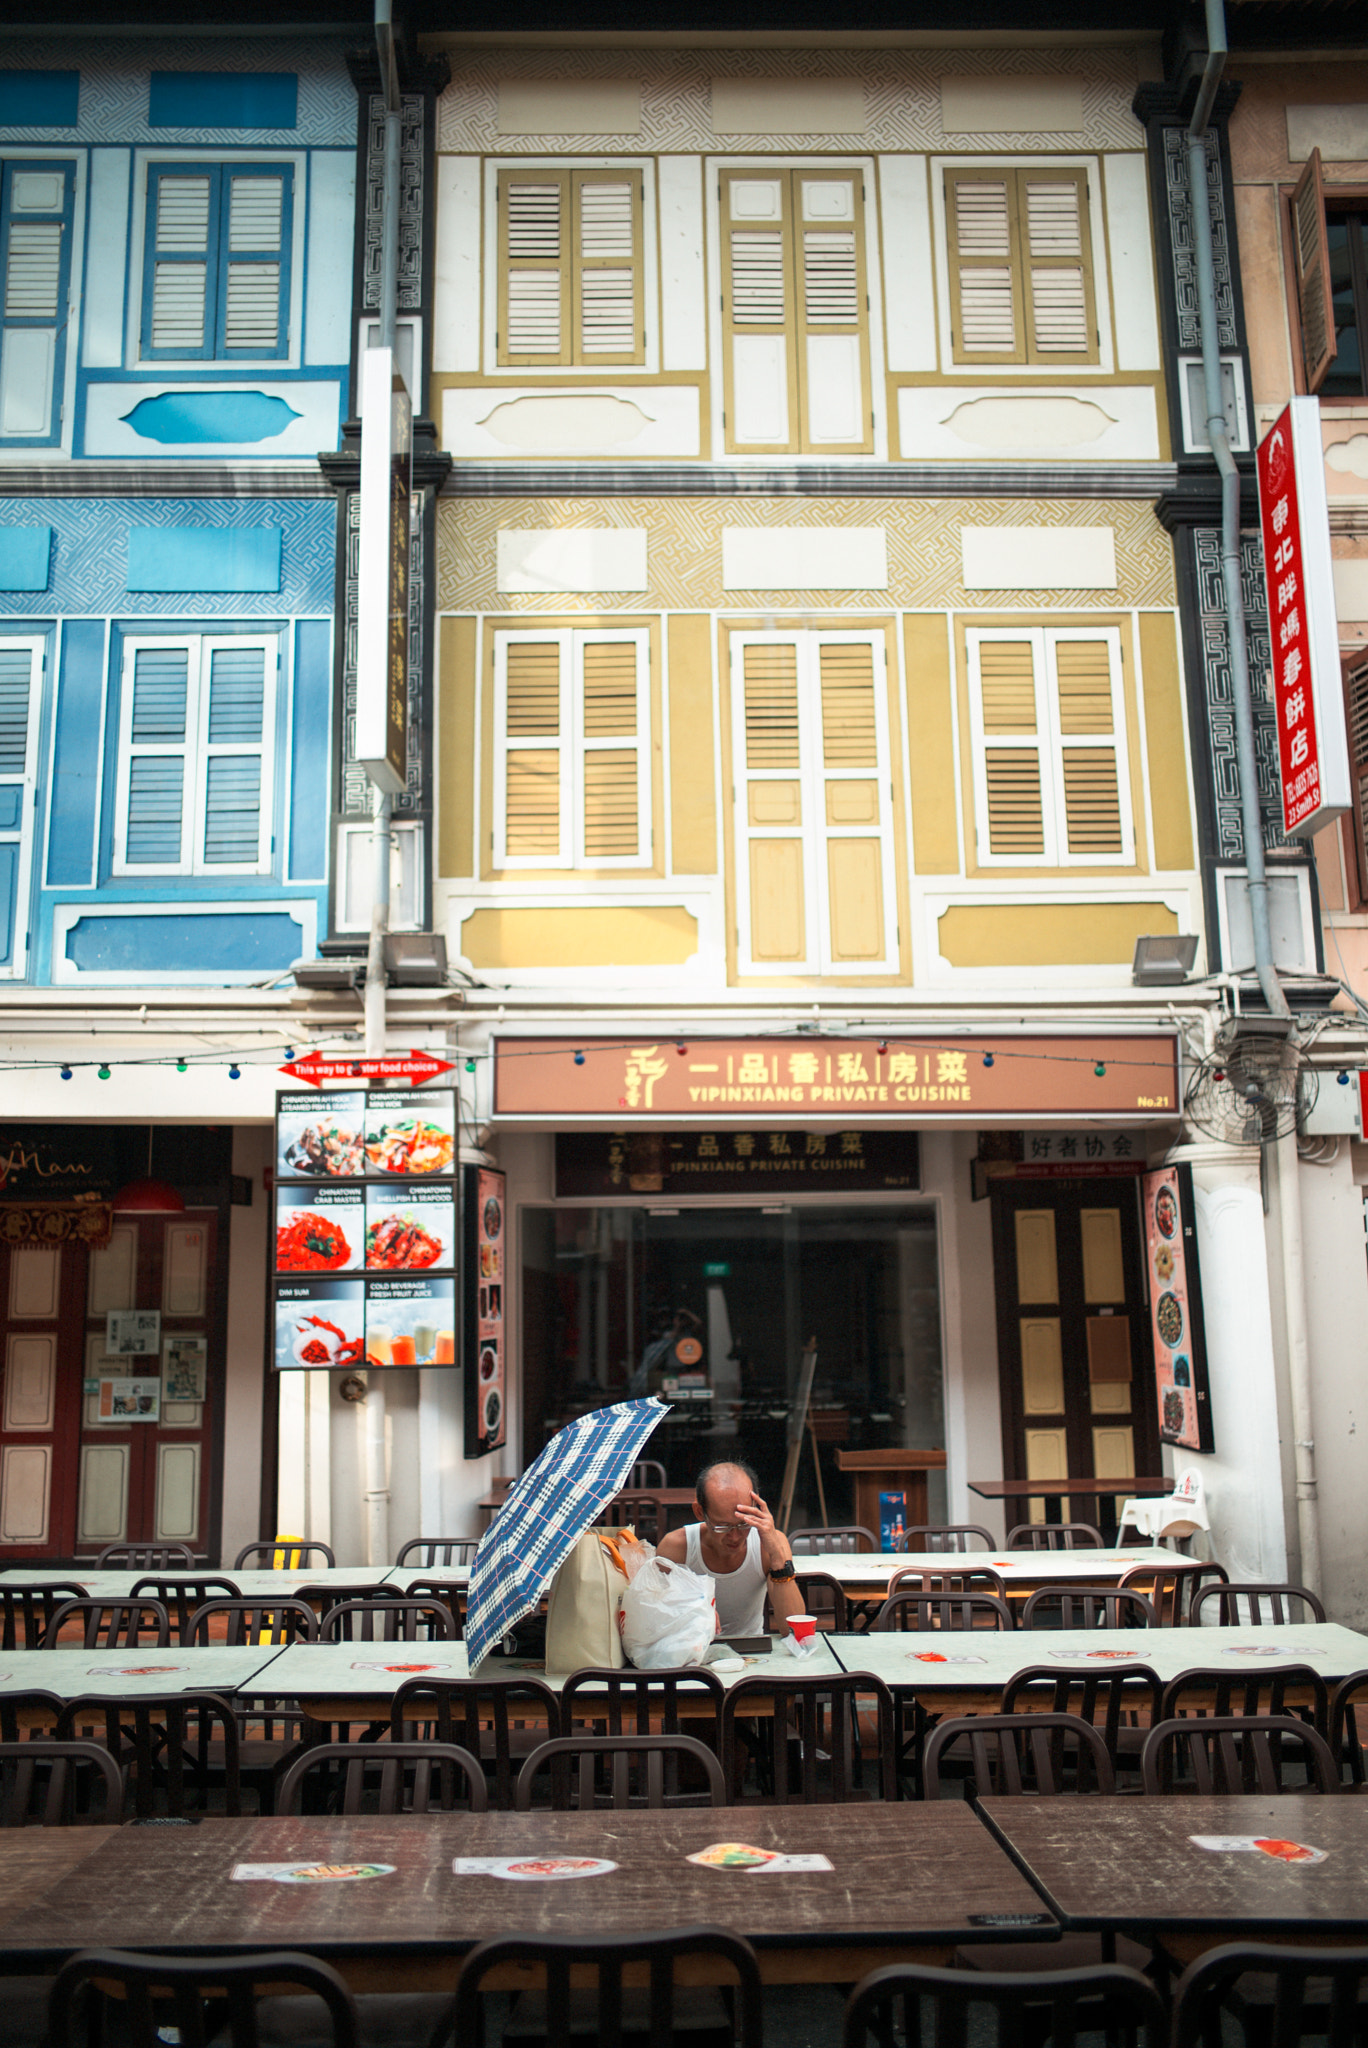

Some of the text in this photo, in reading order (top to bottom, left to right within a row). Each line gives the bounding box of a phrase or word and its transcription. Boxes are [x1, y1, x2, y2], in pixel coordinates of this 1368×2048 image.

[1296, 792, 1314, 819] Smith
[295, 1065, 315, 1075] This
[316, 1065, 334, 1076] way
[335, 1064, 345, 1074] to
[380, 1061, 400, 1072] food
[401, 1062, 439, 1073] choices
[688, 1085, 971, 1102] YIPINXIANG PRIVATE CUISINE
[1137, 1096, 1169, 1107] No.21
[1031, 1134, 1133, 1158] 好者协会
[671, 1157, 866, 1172] IPINXIANG PRIVATE CUISINE
[318, 1188, 361, 1196] CHINATOWN
[409, 1186, 452, 1194] CHINATOWN
[369, 1282, 389, 1290] COLD
[390, 1281, 426, 1290] BEVERAGE
[278, 1288, 310, 1297] DIM SUM
[369, 1290, 392, 1298] FRESH
